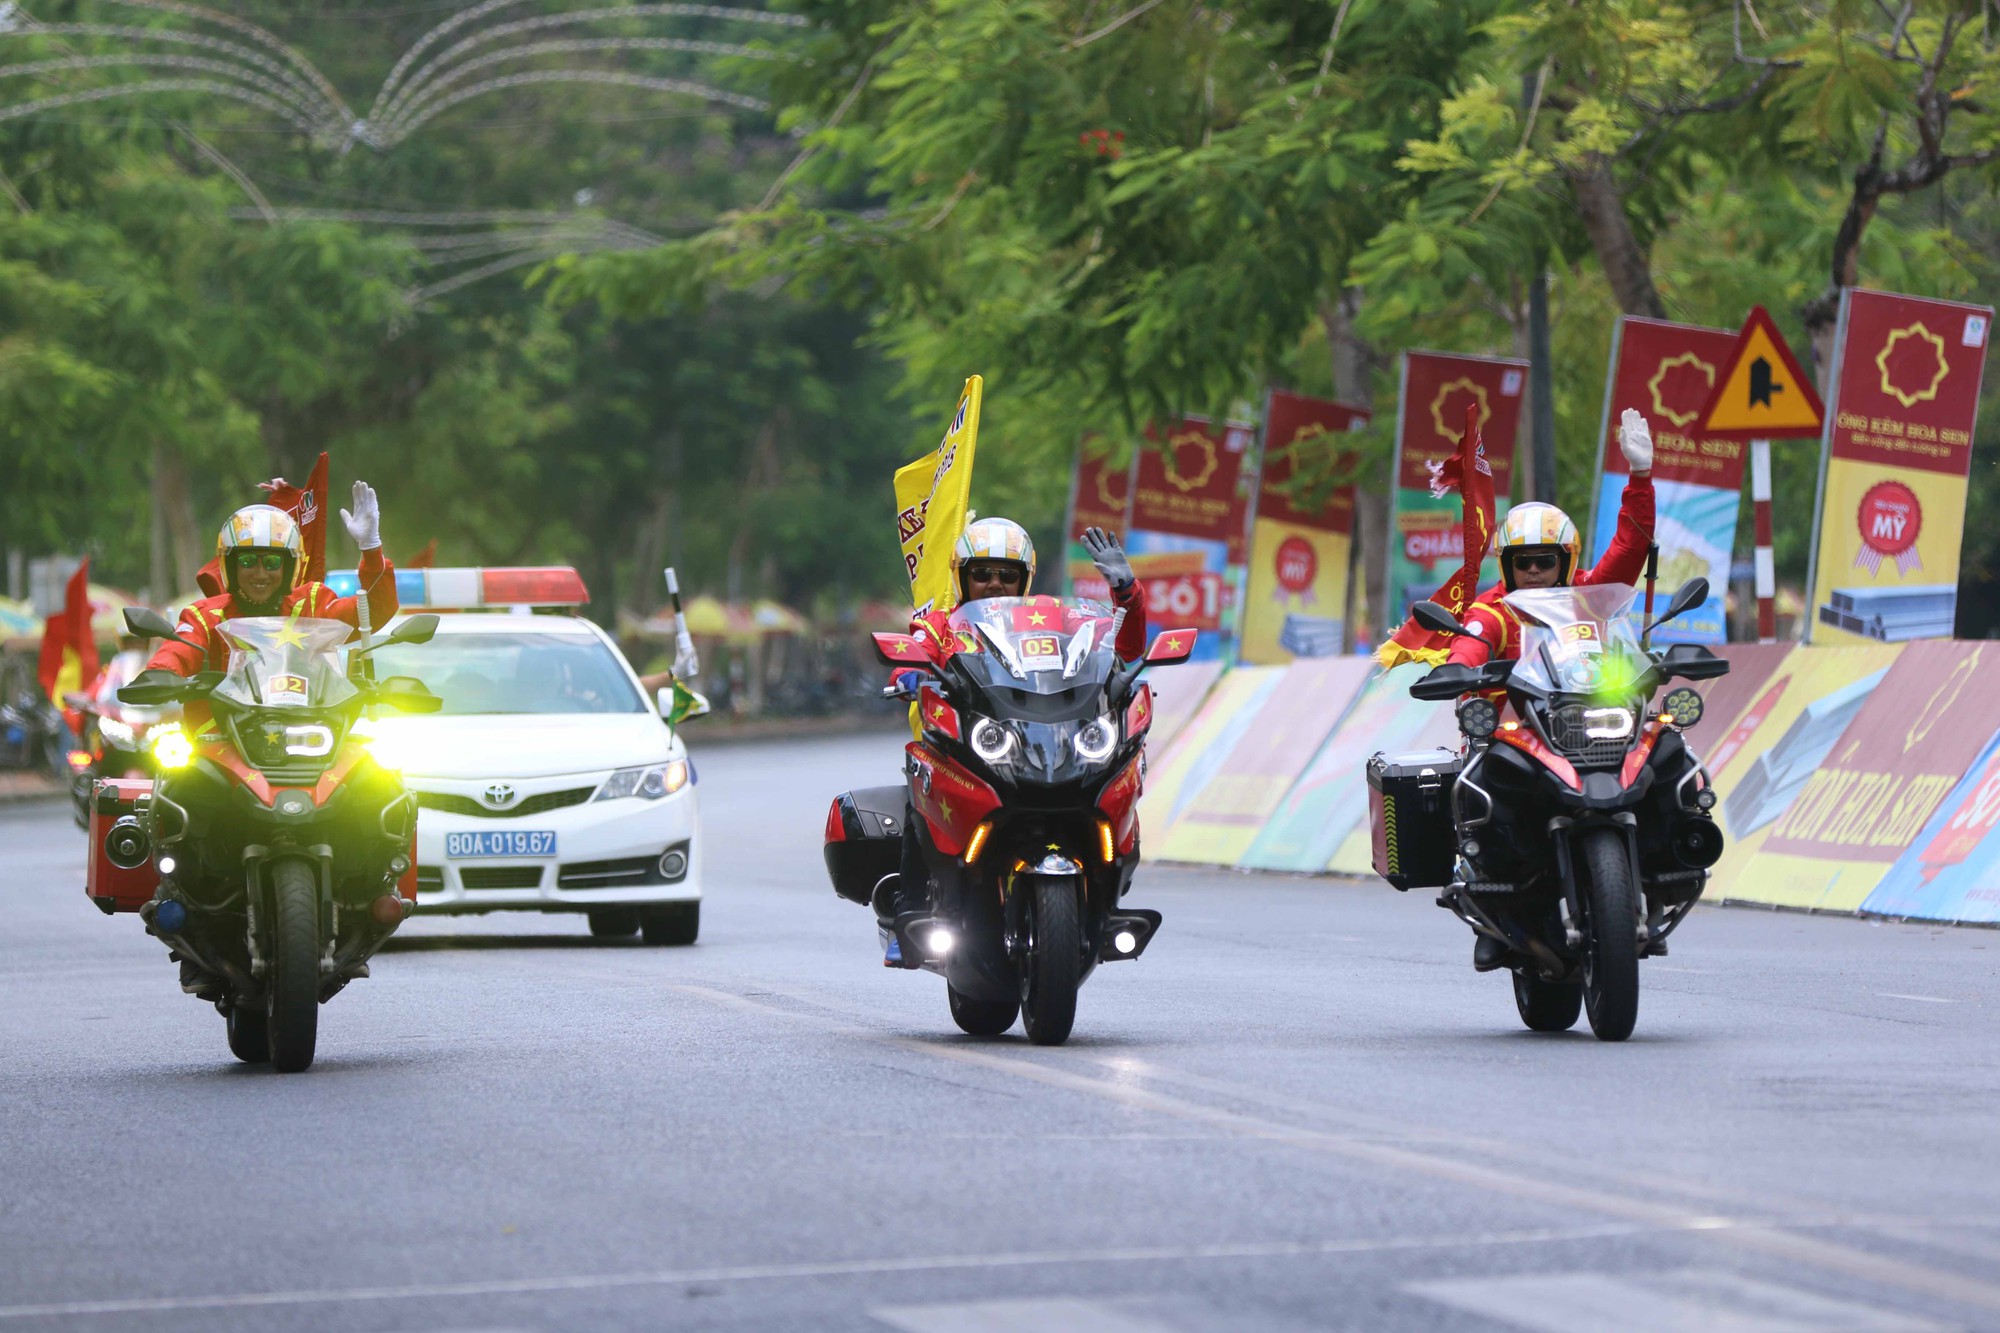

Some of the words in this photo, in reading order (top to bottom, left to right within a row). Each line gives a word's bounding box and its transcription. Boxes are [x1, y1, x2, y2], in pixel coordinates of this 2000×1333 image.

[1656, 431, 1696, 453] HOA
[1700, 440, 1740, 459] SEN
[1907, 422, 1937, 441] HOA
[1940, 428, 1969, 446] SEN
[1872, 511, 1907, 540] MỸ
[1202, 577, 1220, 619] 1
[1566, 624, 1592, 641] 39
[1025, 639, 1055, 655] 05
[274, 677, 302, 692] 02
[1819, 772, 1904, 845] HOA
[1869, 773, 1958, 848] SEN
